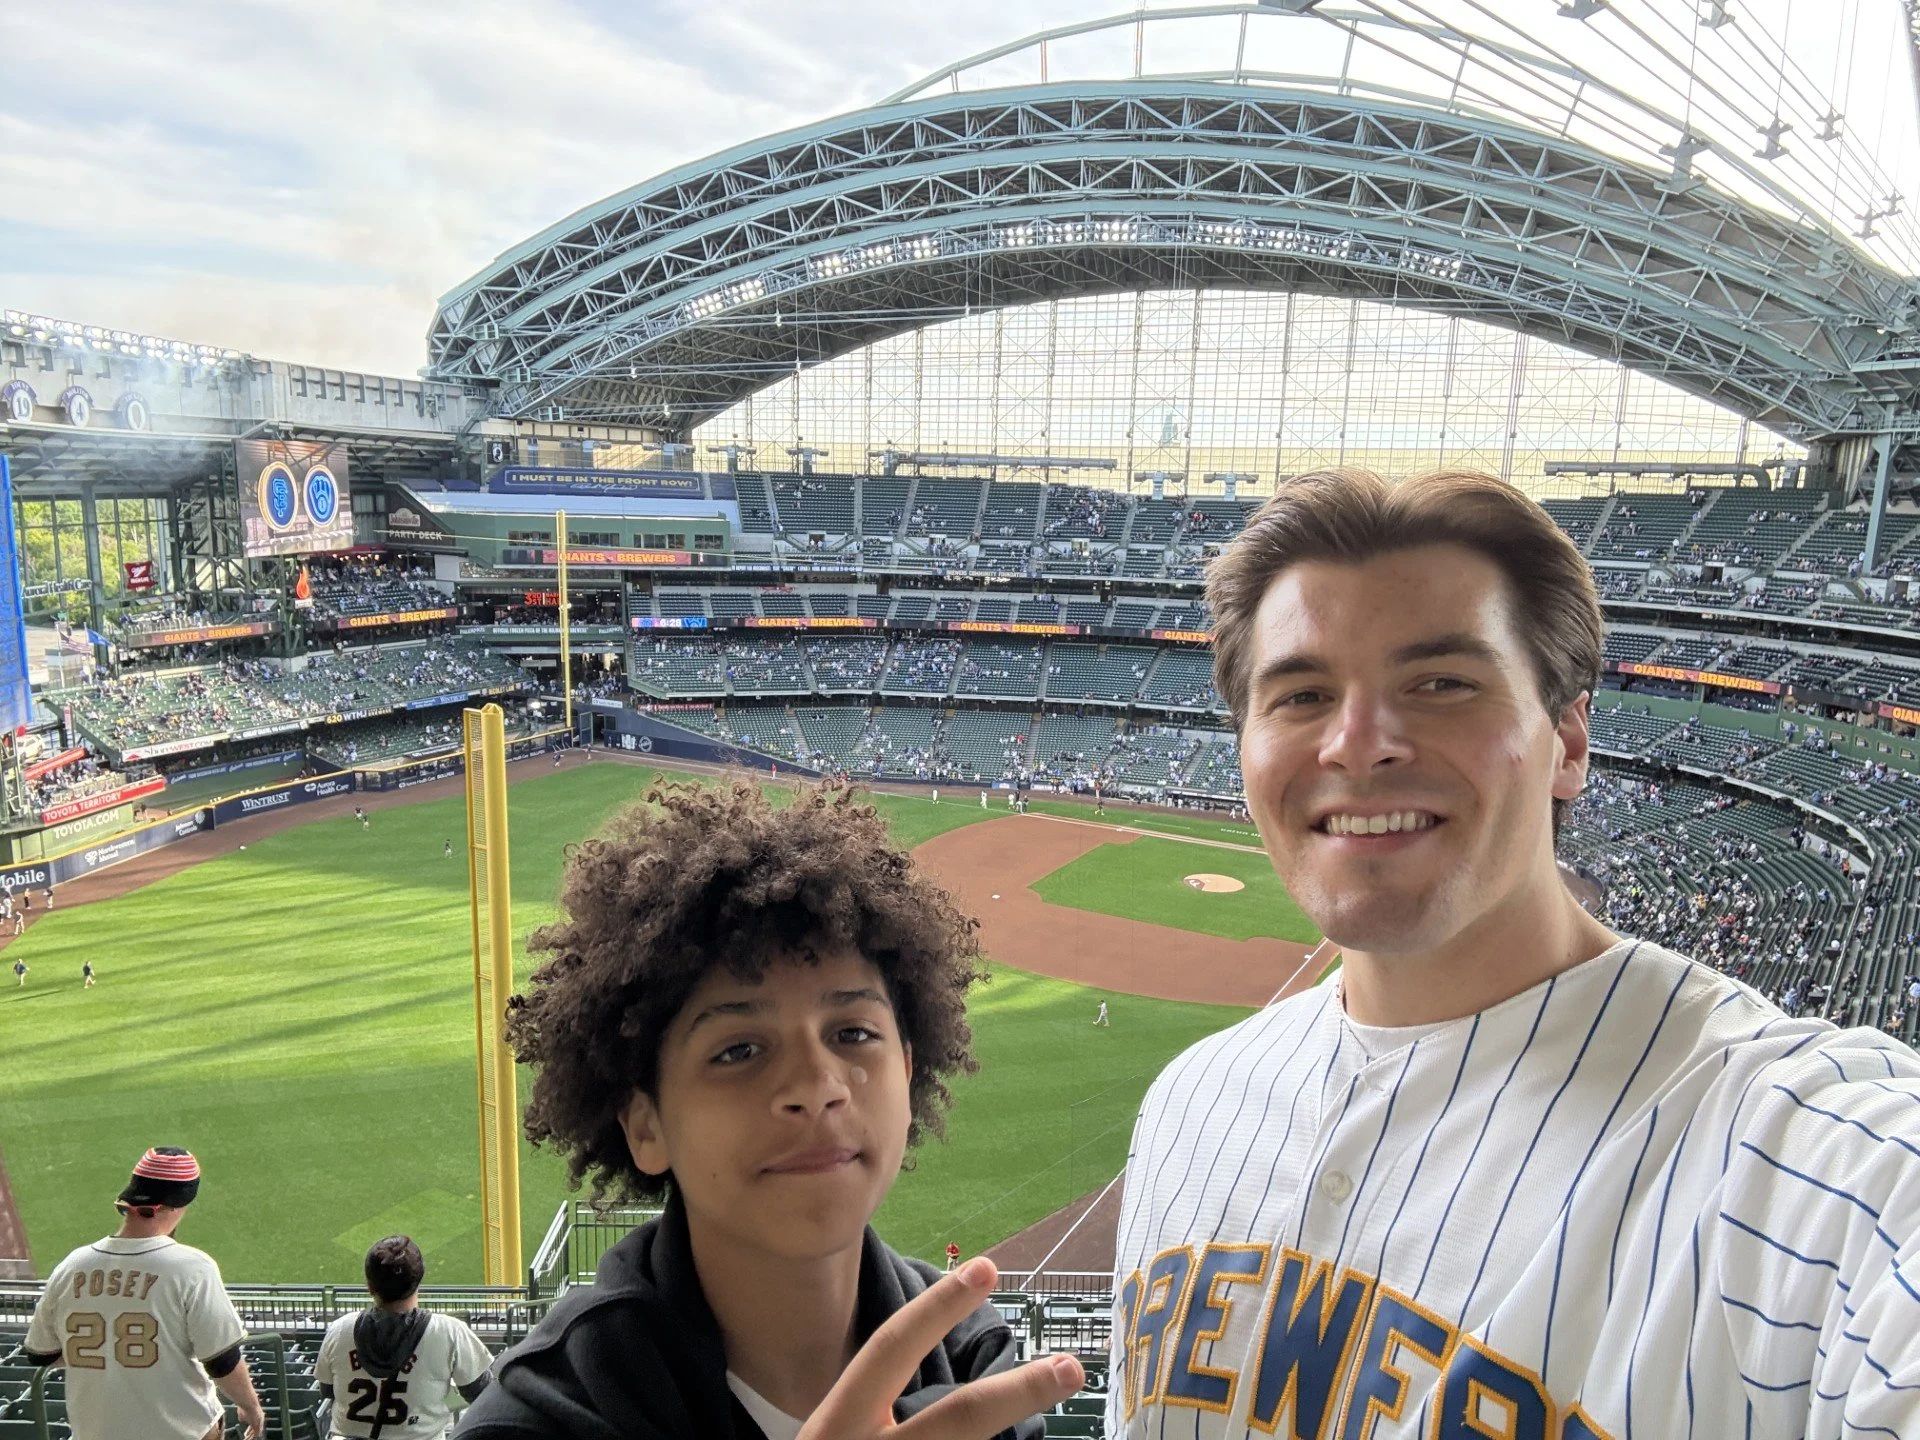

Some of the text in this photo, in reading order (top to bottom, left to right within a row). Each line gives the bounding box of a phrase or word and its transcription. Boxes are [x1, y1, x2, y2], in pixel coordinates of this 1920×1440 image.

[17, 397, 30, 417] 19
[520, 474, 551, 482] MUST
[575, 475, 589, 483] IN
[591, 476, 614, 484] THE
[617, 477, 657, 486] FRONT
[661, 479, 693, 487] ROW!
[389, 530, 442, 540] PARTY DECK
[616, 552, 676, 563] BREWERS
[350, 609, 446, 627] GIANTS BREWERS
[758, 618, 864, 626] GIANTS BREWERS
[164, 626, 252, 643] GIANTS BREWERS
[960, 622, 1066, 634] GIANTS BREWERS
[1164, 631, 1207, 641] GIANTS
[1633, 664, 1764, 692] GIANTS BREWERS
[326, 714, 343, 725] 620
[343, 708, 367, 721] WTMJ
[316, 781, 336, 790] Aurora
[316, 784, 349, 796] Health Care
[44, 791, 122, 821] TOYOTA TERRITORY
[241, 791, 291, 810] WINTRUST
[54, 809, 120, 839] TOYOTA.COM
[97, 839, 135, 855] Northwestern
[98, 851, 120, 863] Mutual
[73, 1269, 159, 1300] POSEY
[65, 1311, 159, 1370] 28
[346, 1377, 408, 1426] 25
